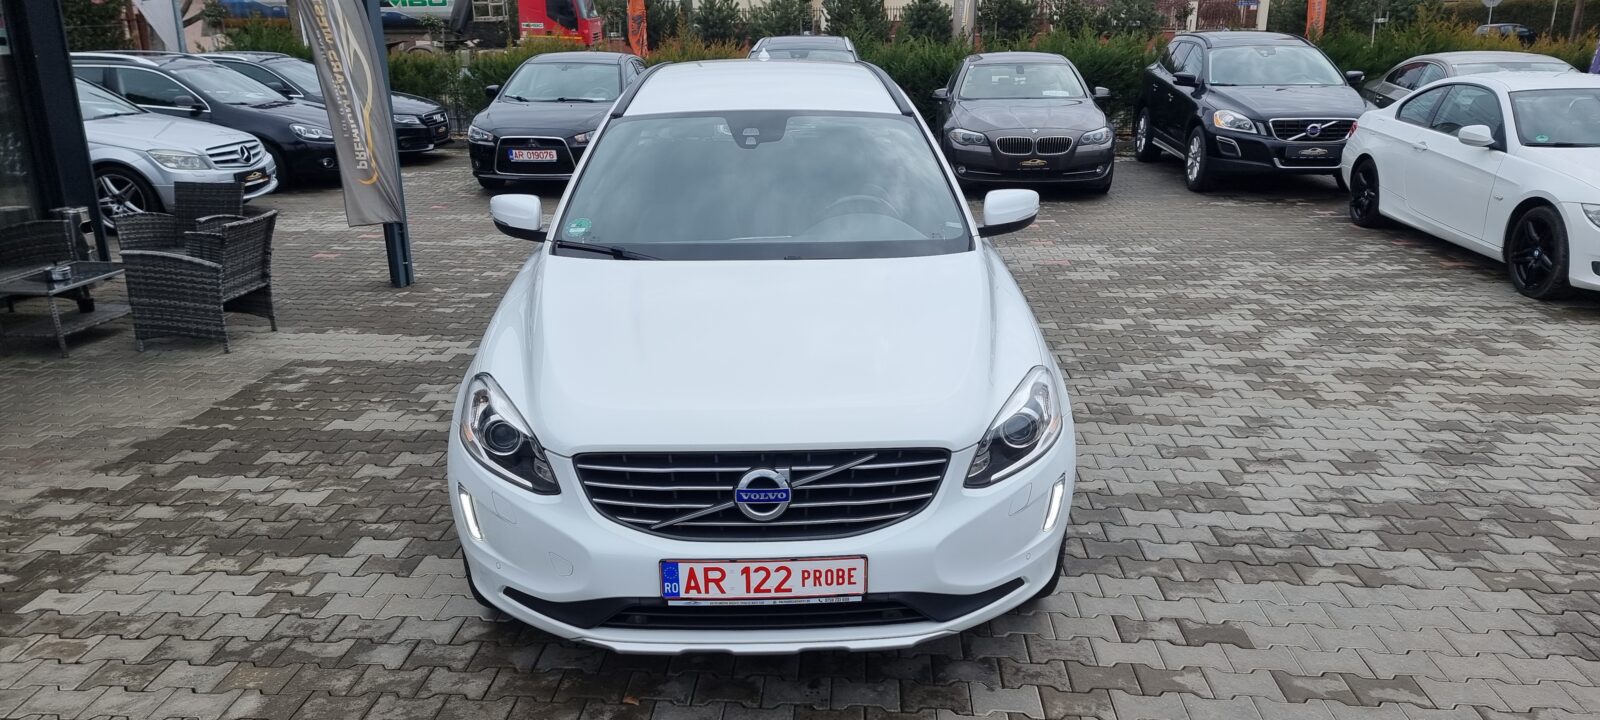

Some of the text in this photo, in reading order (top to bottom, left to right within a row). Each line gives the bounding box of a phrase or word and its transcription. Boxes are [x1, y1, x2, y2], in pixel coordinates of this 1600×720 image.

[514, 151, 554, 159] AR 019076
[740, 492, 787, 500] VOLVO
[684, 565, 857, 594] AR 122 PROBE
[665, 582, 679, 593] RO
